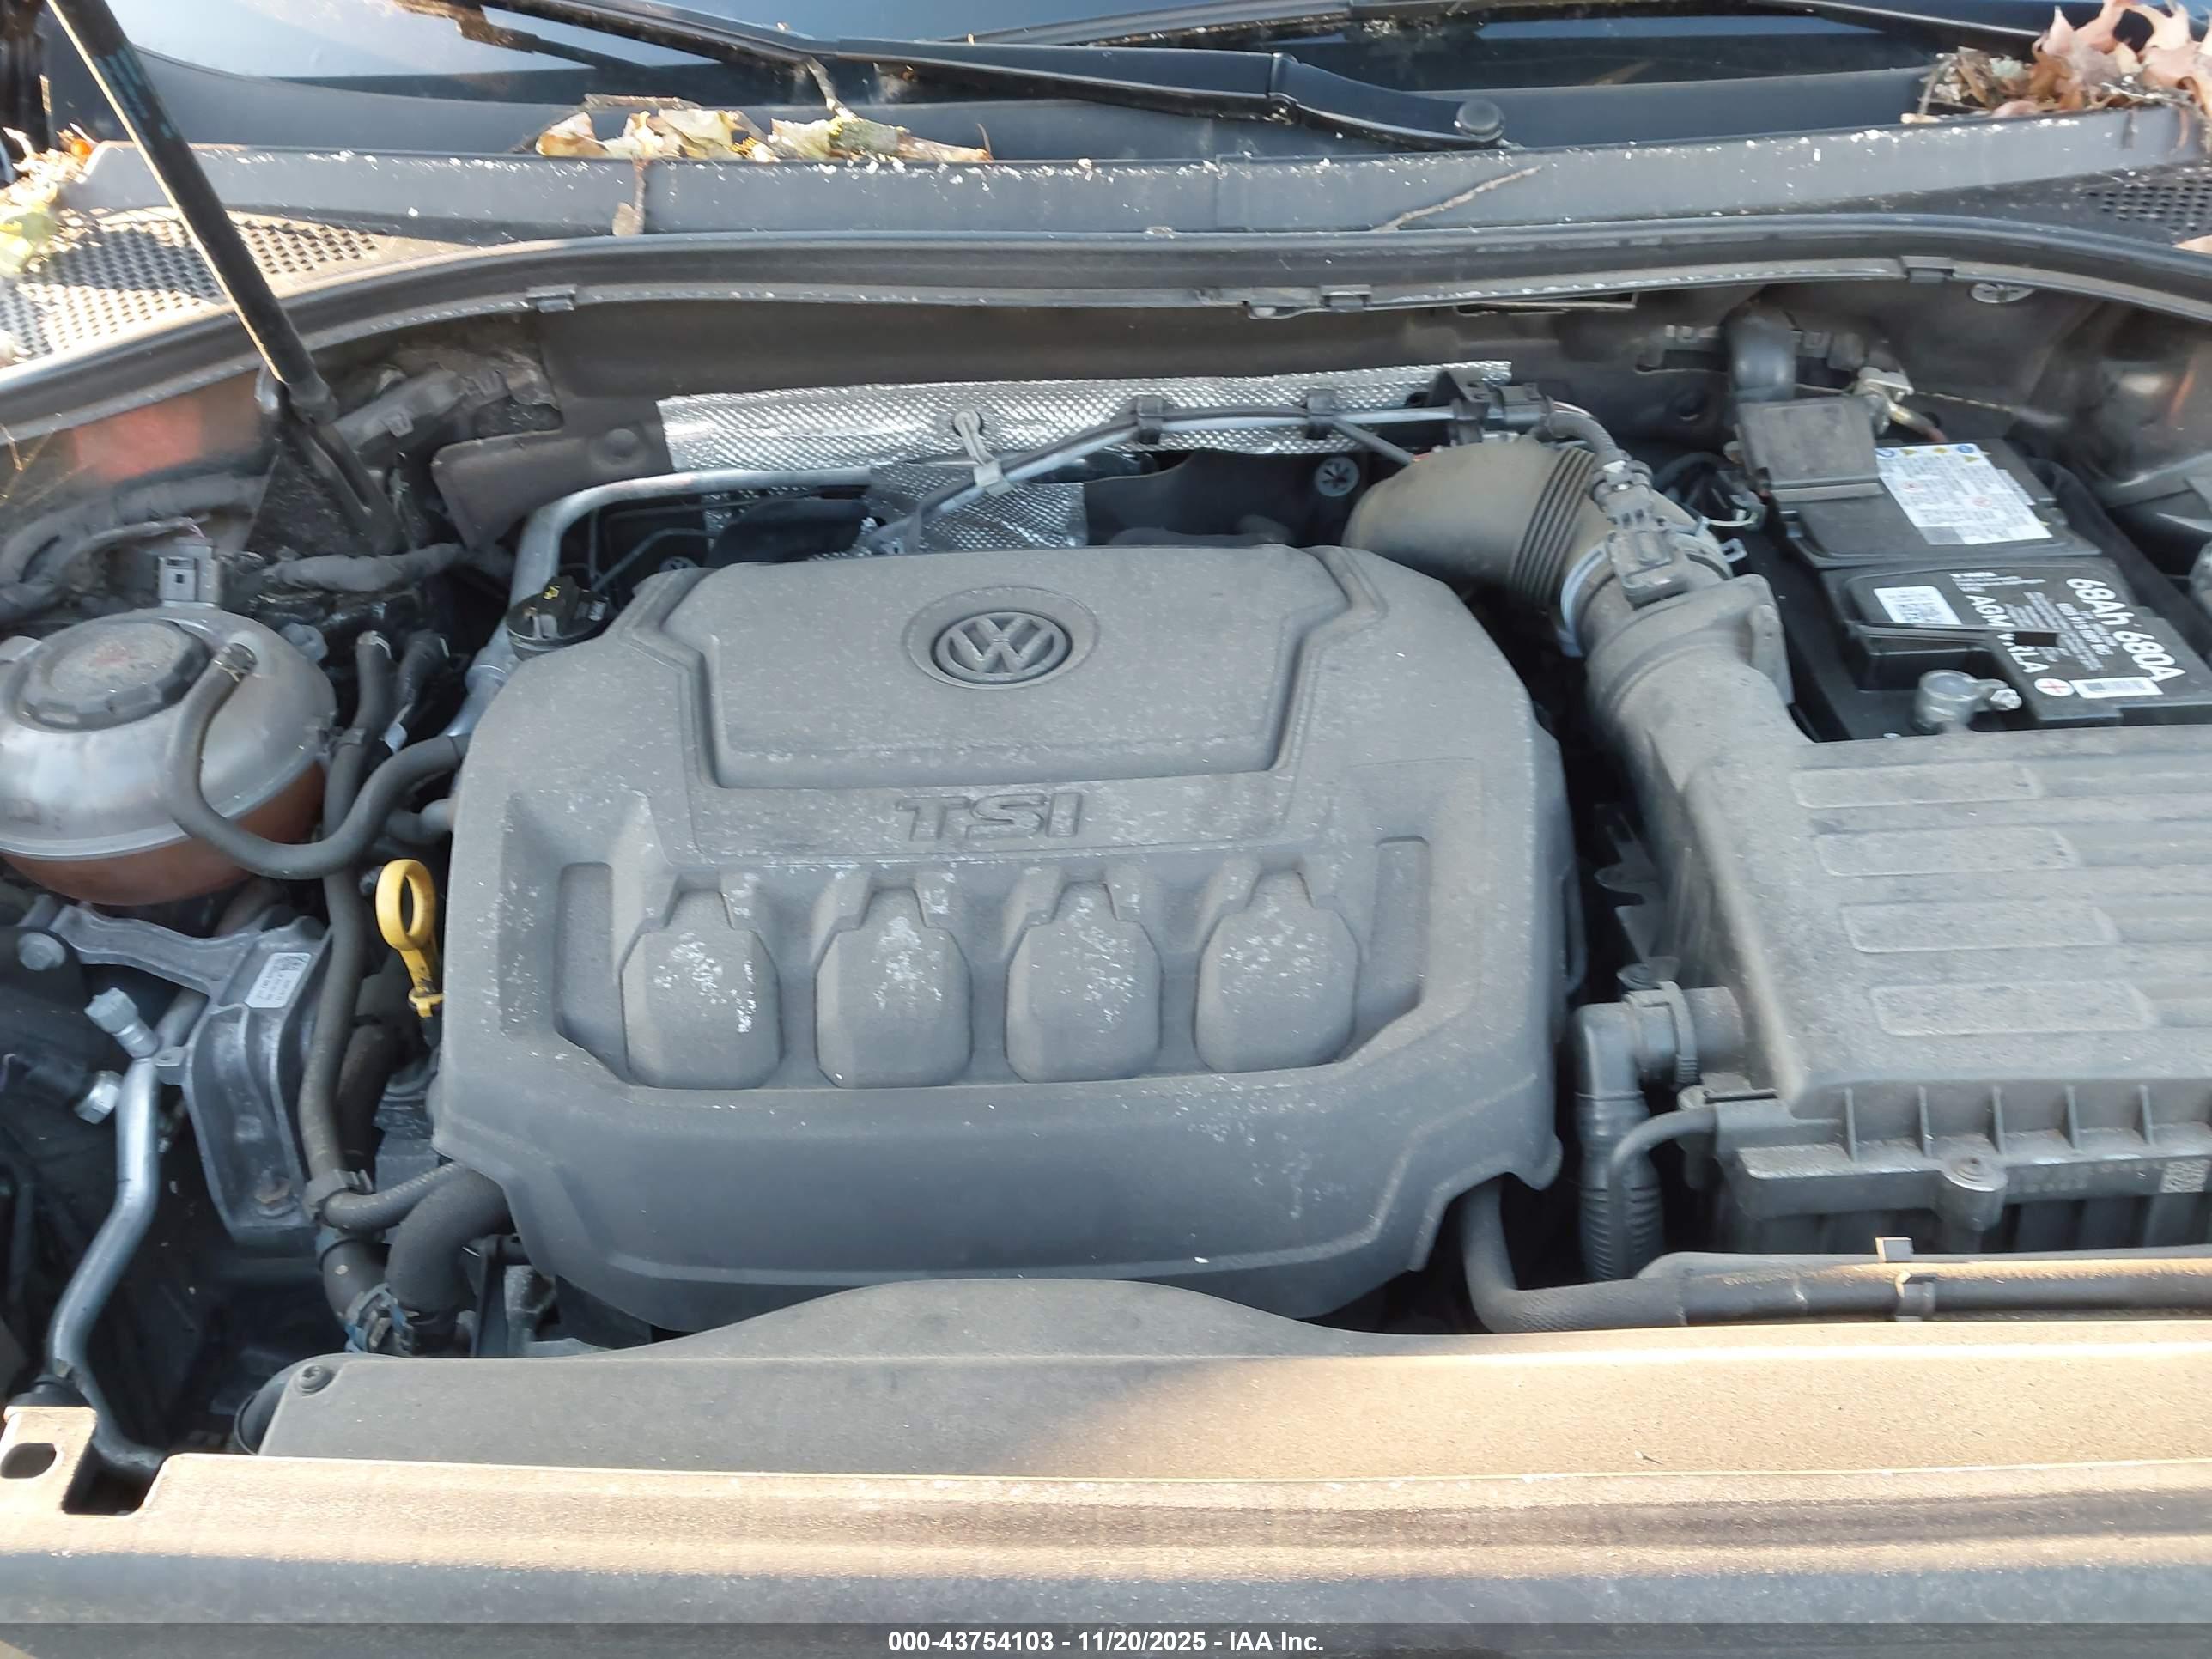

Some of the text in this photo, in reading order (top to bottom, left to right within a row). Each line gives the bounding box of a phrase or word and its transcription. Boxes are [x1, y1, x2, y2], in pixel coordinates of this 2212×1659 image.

[1966, 595, 2015, 628] AGM
[2066, 578, 2135, 626] 68Ah
[2112, 630, 2186, 682] 680A
[895, 792, 1084, 842] TSI
